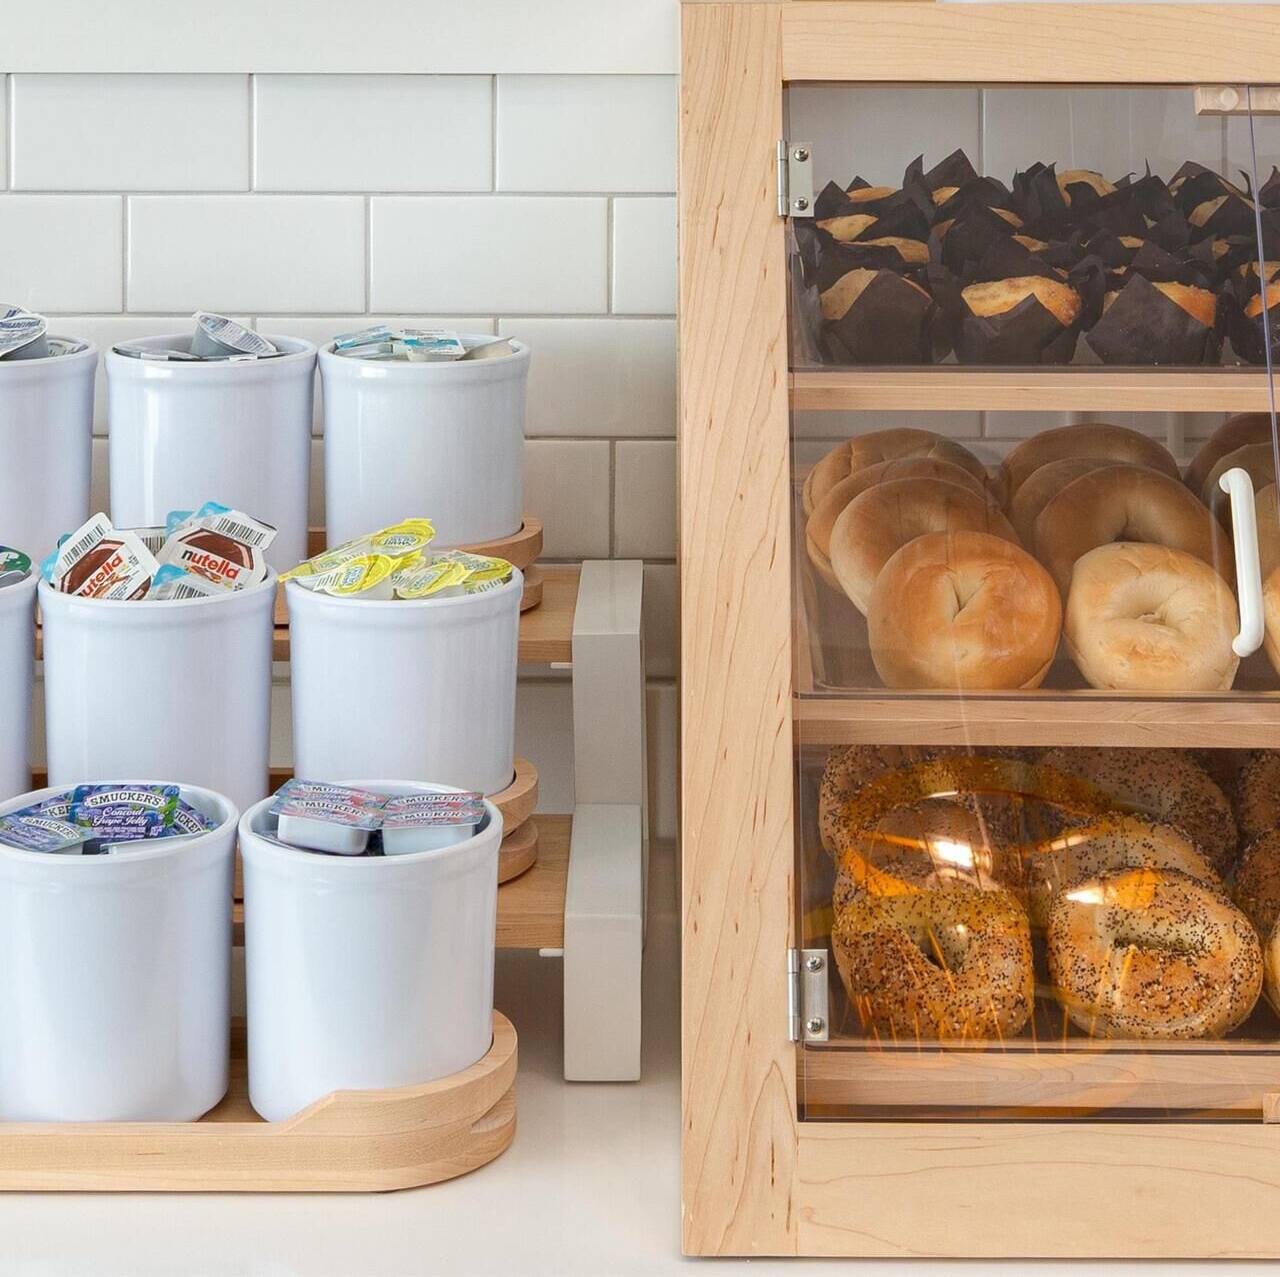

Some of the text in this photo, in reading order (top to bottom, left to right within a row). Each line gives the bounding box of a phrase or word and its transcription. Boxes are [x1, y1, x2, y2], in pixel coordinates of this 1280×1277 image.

[180, 549, 240, 580] nutella
[90, 791, 162, 806] SMUCKER'S
[102, 806, 145, 817] Concord
[91, 815, 149, 827] Grape Jelly
